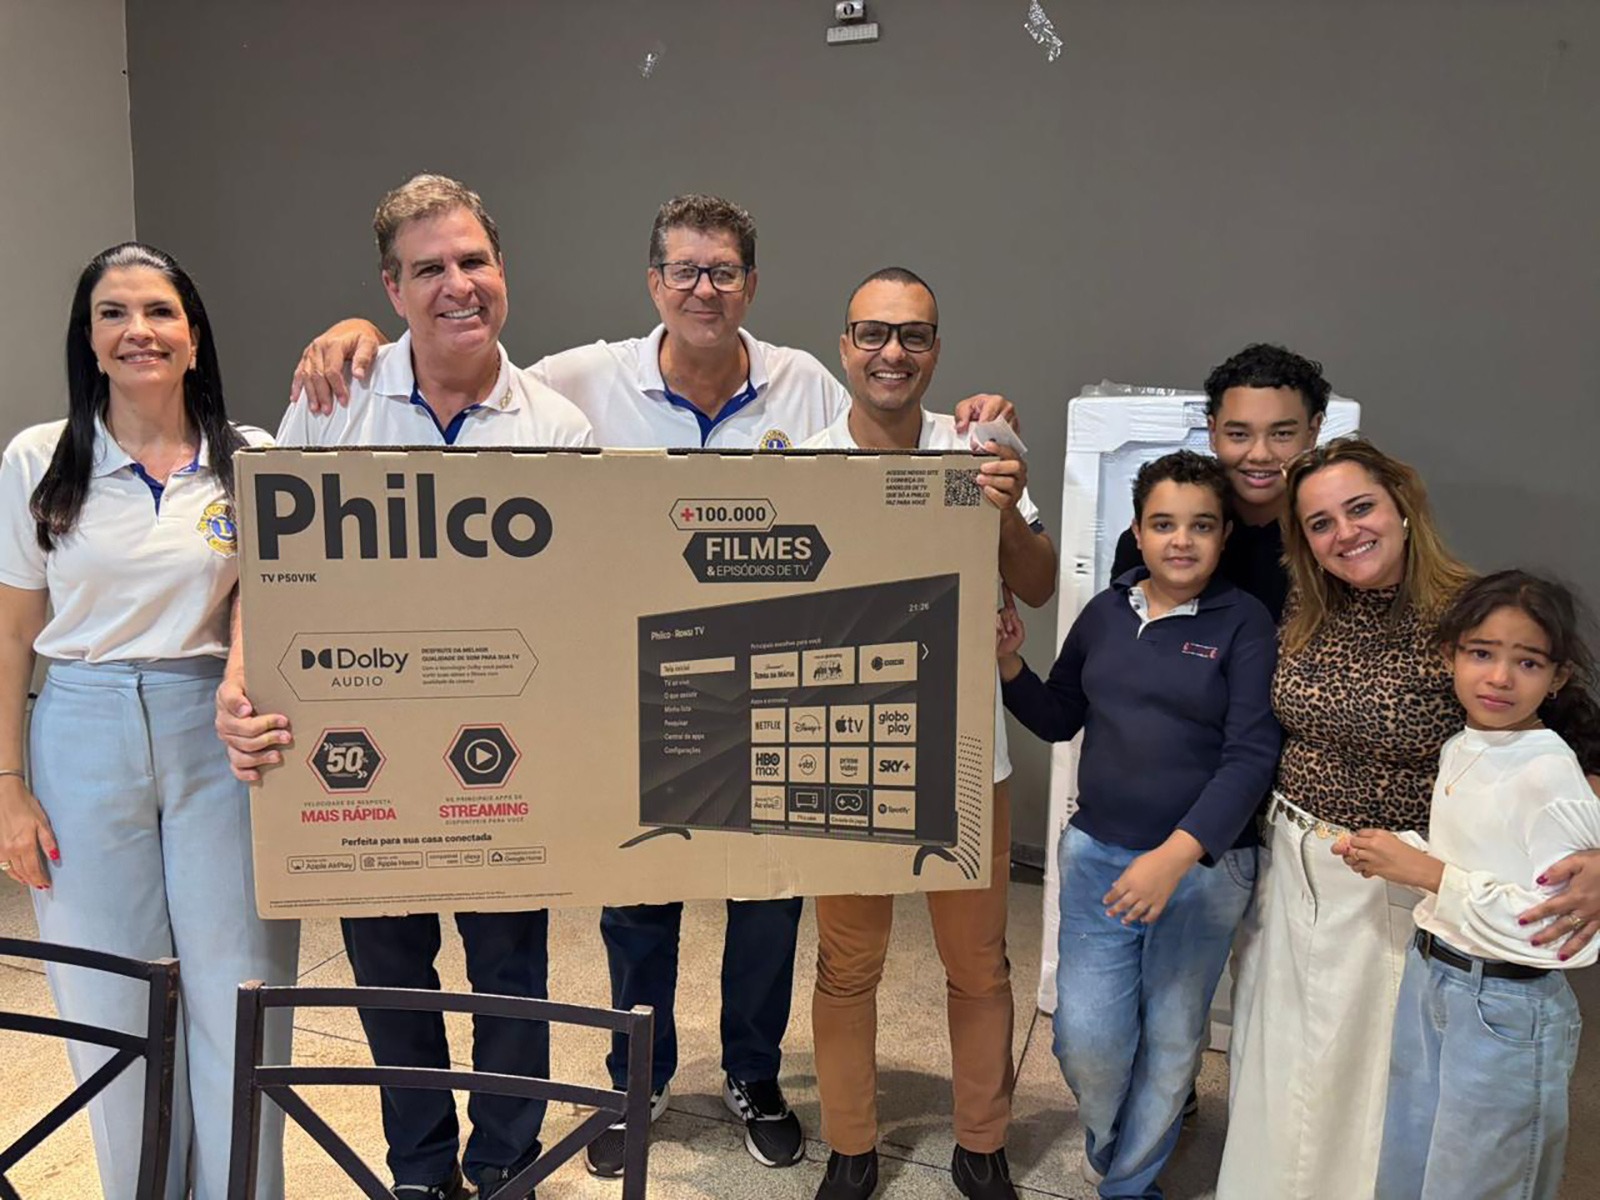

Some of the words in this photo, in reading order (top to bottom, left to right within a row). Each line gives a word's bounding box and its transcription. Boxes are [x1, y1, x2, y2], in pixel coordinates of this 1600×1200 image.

[254, 472, 553, 560] Philco
[681, 507, 766, 522] +100.000
[706, 536, 812, 561] FILMES
[777, 565, 791, 576] DE
[260, 573, 275, 583] TV
[277, 573, 317, 583] P50VIK
[651, 631, 671, 640] Philco
[694, 626, 705, 635] TV
[337, 647, 409, 673] Dolby
[331, 676, 383, 687] AUDIO
[878, 710, 909, 724] globo
[755, 720, 780, 730] NETFLIX
[887, 722, 911, 736] play
[755, 752, 780, 766] HBO
[878, 759, 910, 773] SKY+
[755, 767, 779, 776] max
[301, 810, 339, 823] MAIS
[342, 805, 397, 822] RÁPIDA
[439, 802, 529, 818] STREAMING
[888, 805, 908, 814] Spotify
[341, 838, 378, 846] Perfeita
[380, 838, 400, 847] para
[445, 833, 492, 843] conectada
